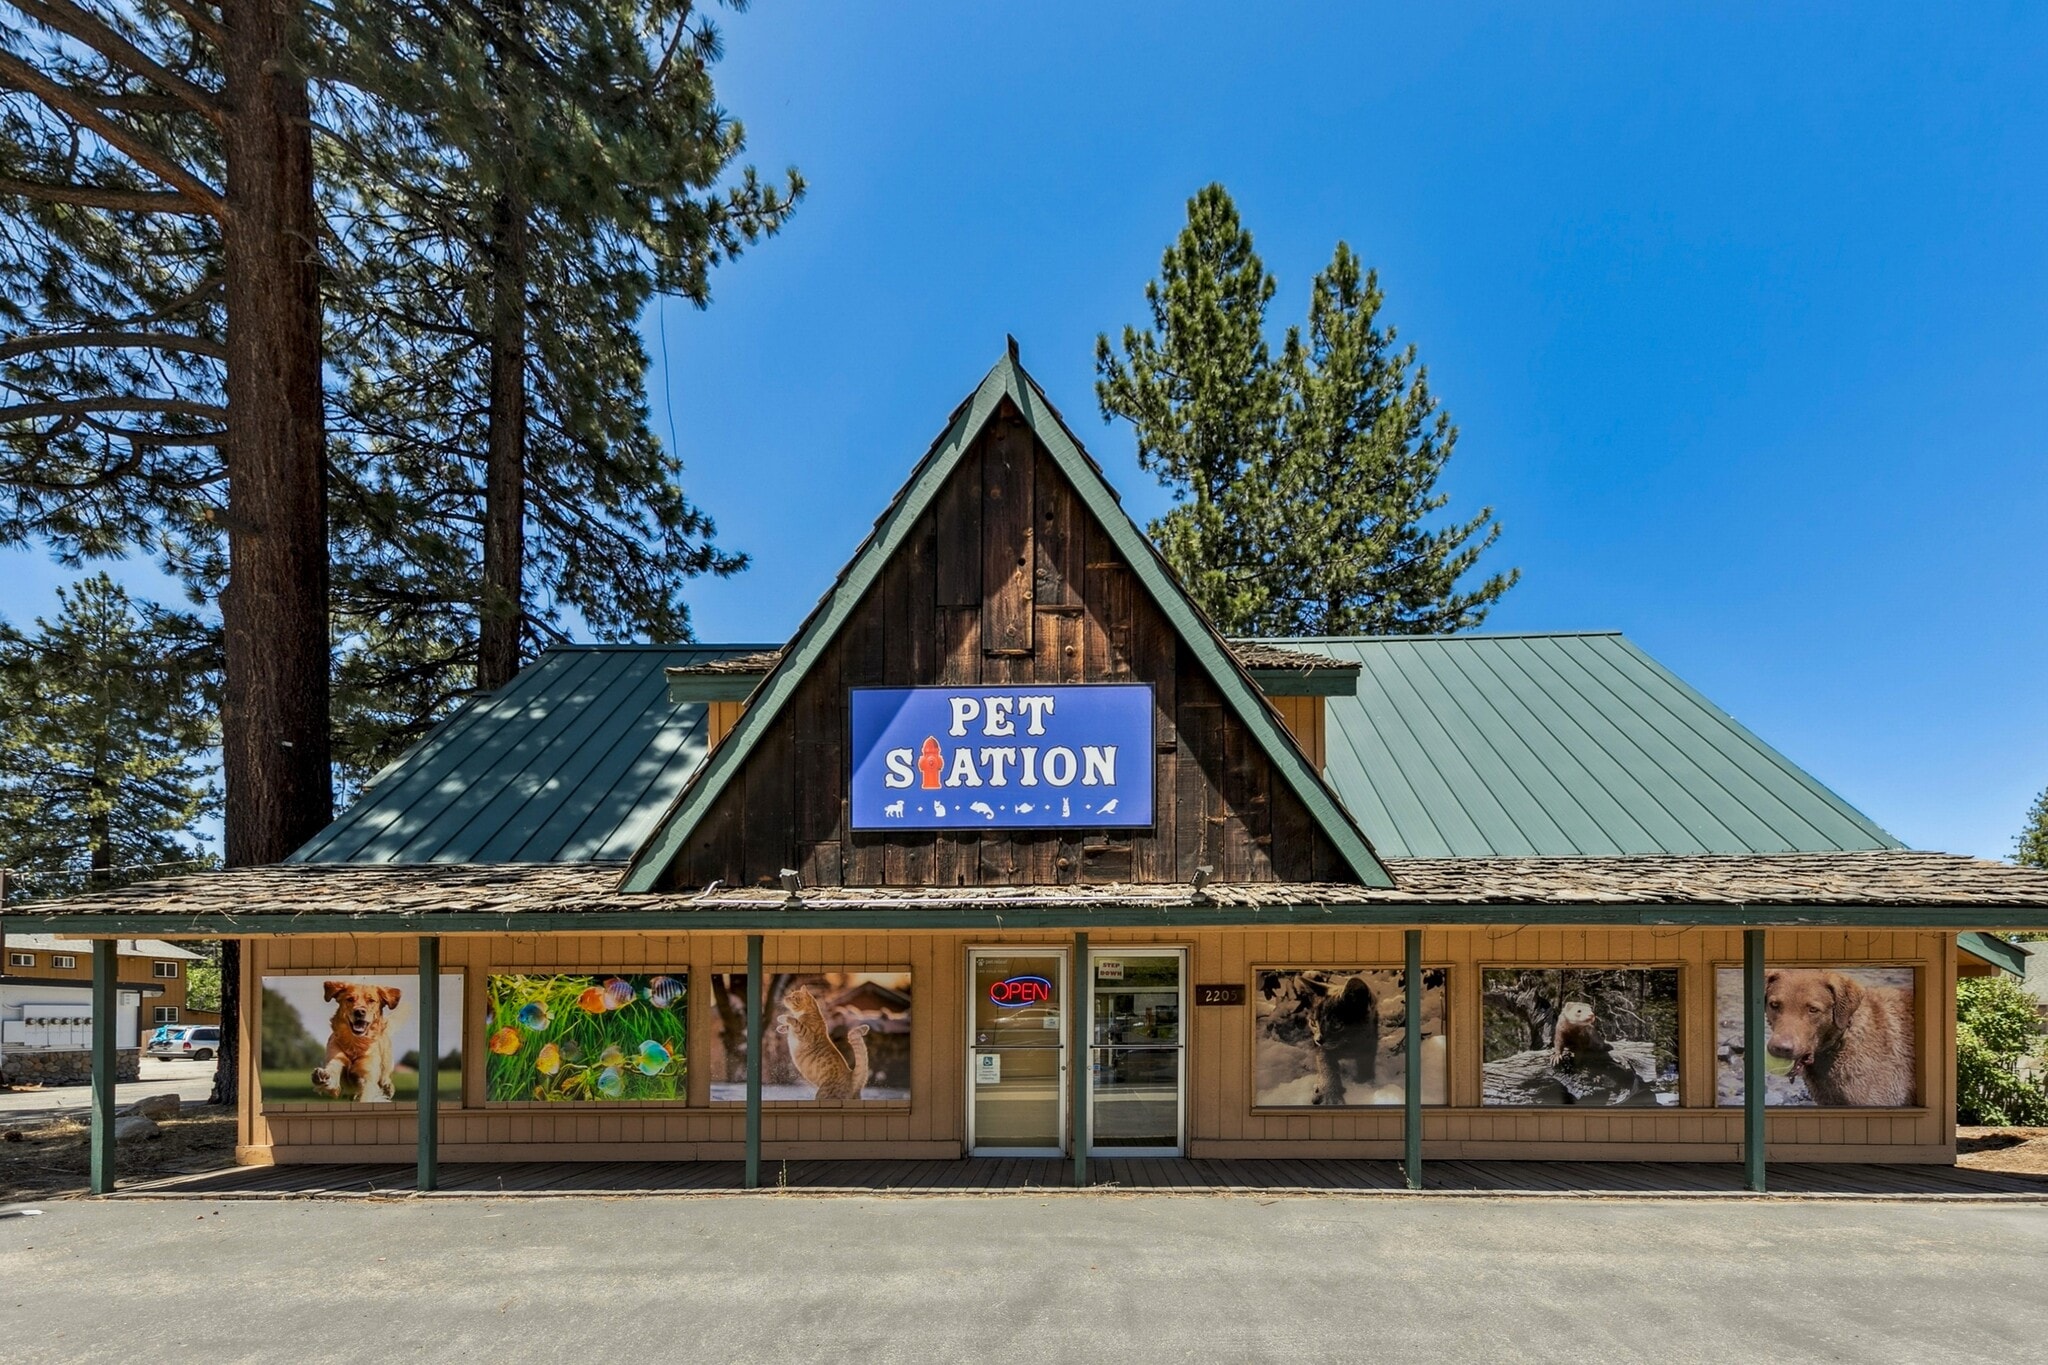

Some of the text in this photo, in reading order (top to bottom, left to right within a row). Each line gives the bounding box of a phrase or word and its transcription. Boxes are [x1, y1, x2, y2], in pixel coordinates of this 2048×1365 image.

[948, 695, 1055, 737] PET
[884, 743, 1119, 789] SATION
[990, 982, 1048, 1001] OPEN
[1205, 990, 1238, 1002] 2205
